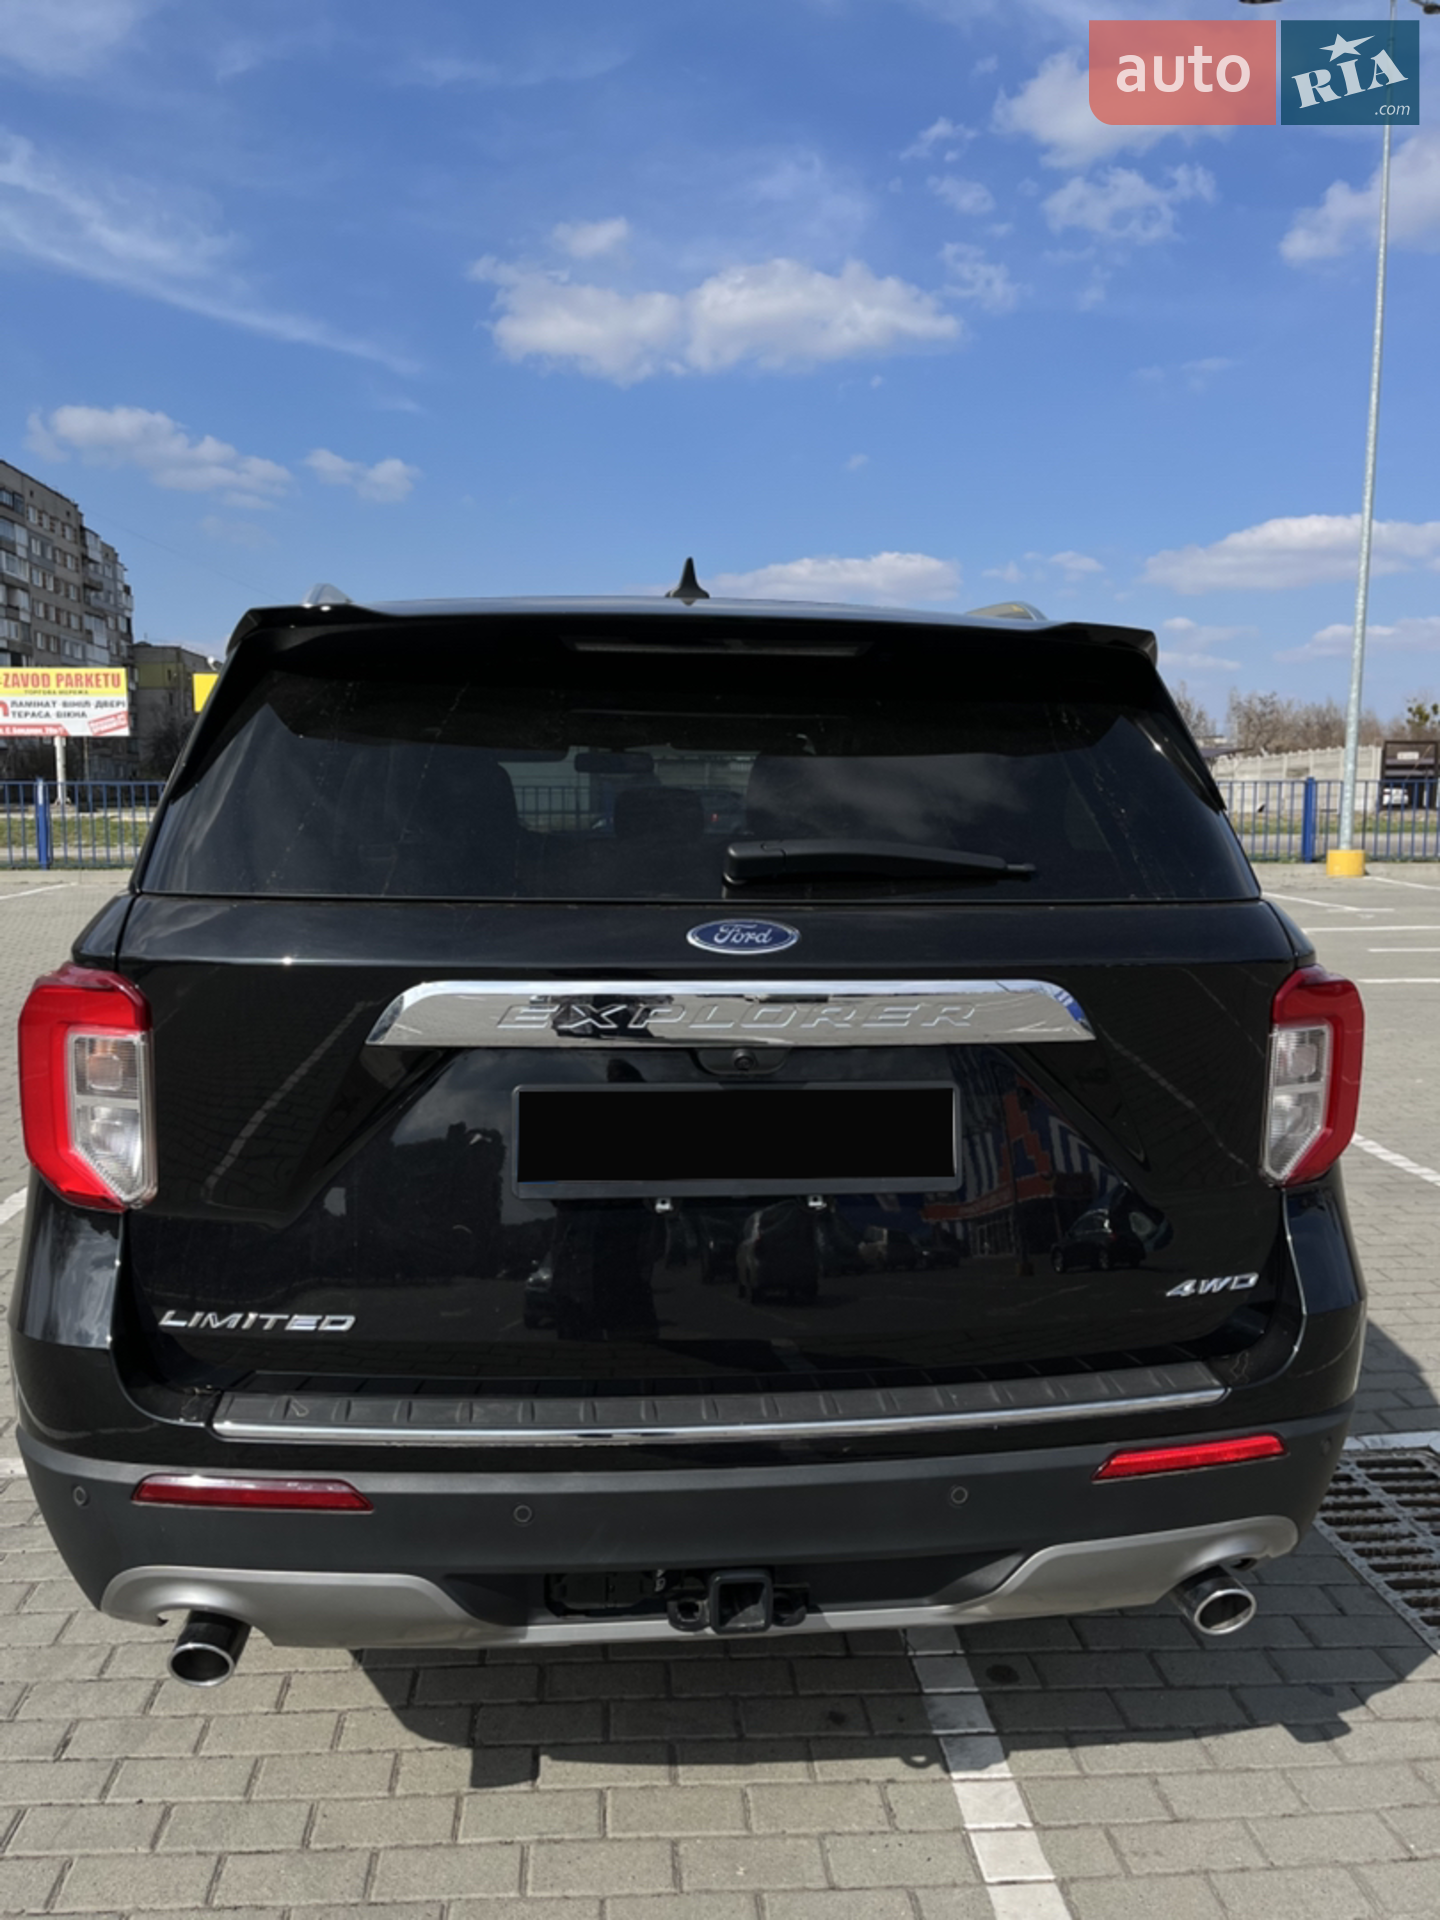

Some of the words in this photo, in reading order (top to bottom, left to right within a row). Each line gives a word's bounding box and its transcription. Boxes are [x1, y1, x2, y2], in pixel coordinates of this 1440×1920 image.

[3, 672, 51, 688] ZAVOD
[56, 672, 122, 688] PARKETU
[10, 700, 57, 708] ЛАМІНАТ
[94, 700, 126, 709] ДВЕРІ
[11, 711, 51, 719] ТЕРАСА
[713, 923, 774, 944] Ford
[497, 1003, 979, 1029] EXPLORER
[1165, 1272, 1259, 1297] 4WD
[158, 1309, 356, 1331] LIMITED
